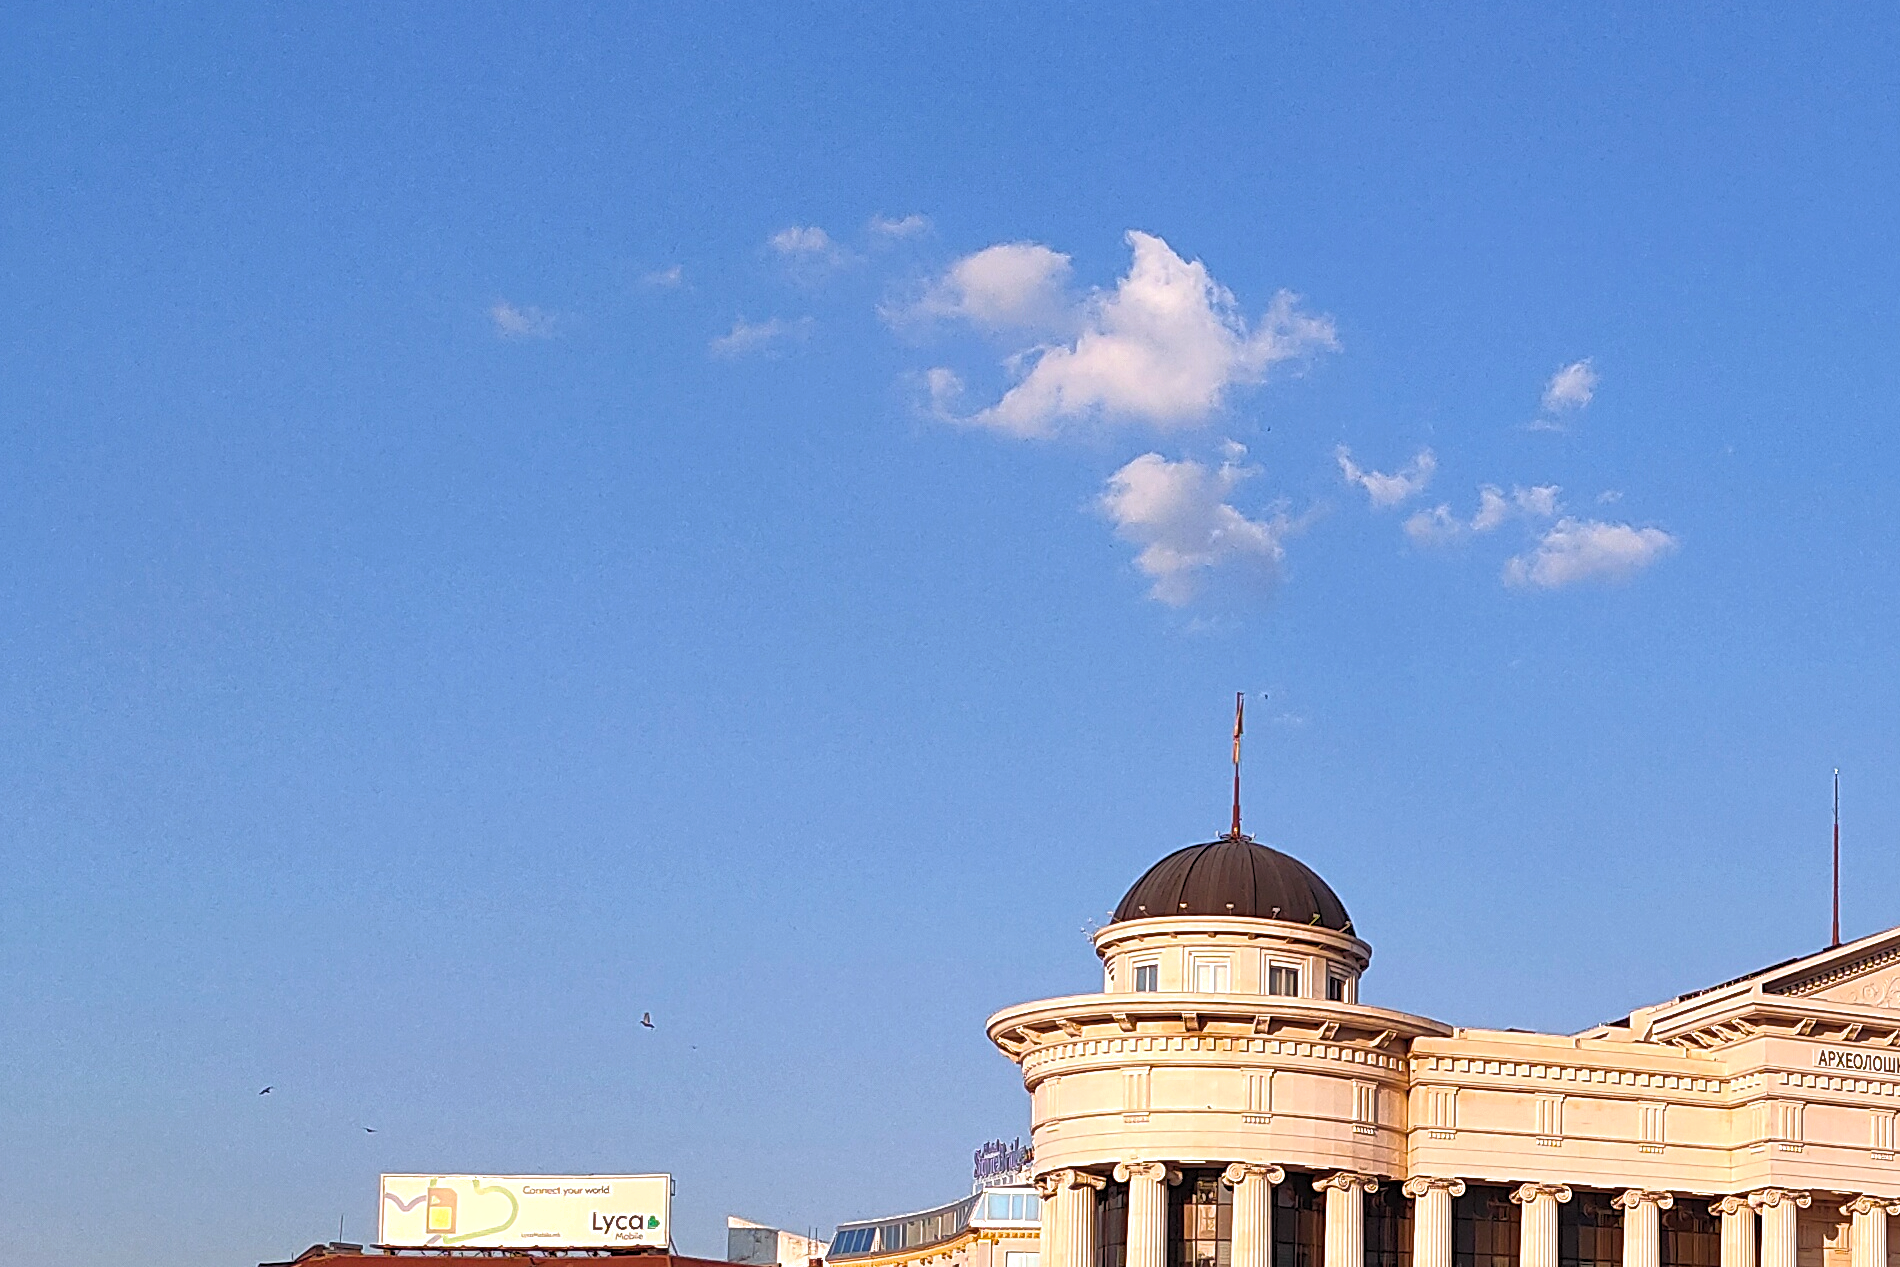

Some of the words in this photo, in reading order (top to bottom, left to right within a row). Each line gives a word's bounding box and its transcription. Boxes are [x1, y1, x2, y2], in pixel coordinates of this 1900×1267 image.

[522, 1185, 561, 1195] Connect
[563, 1187, 583, 1196] your
[585, 1186, 610, 1194] world
[592, 1211, 644, 1234] Lyca
[616, 1232, 644, 1240] Mobile
